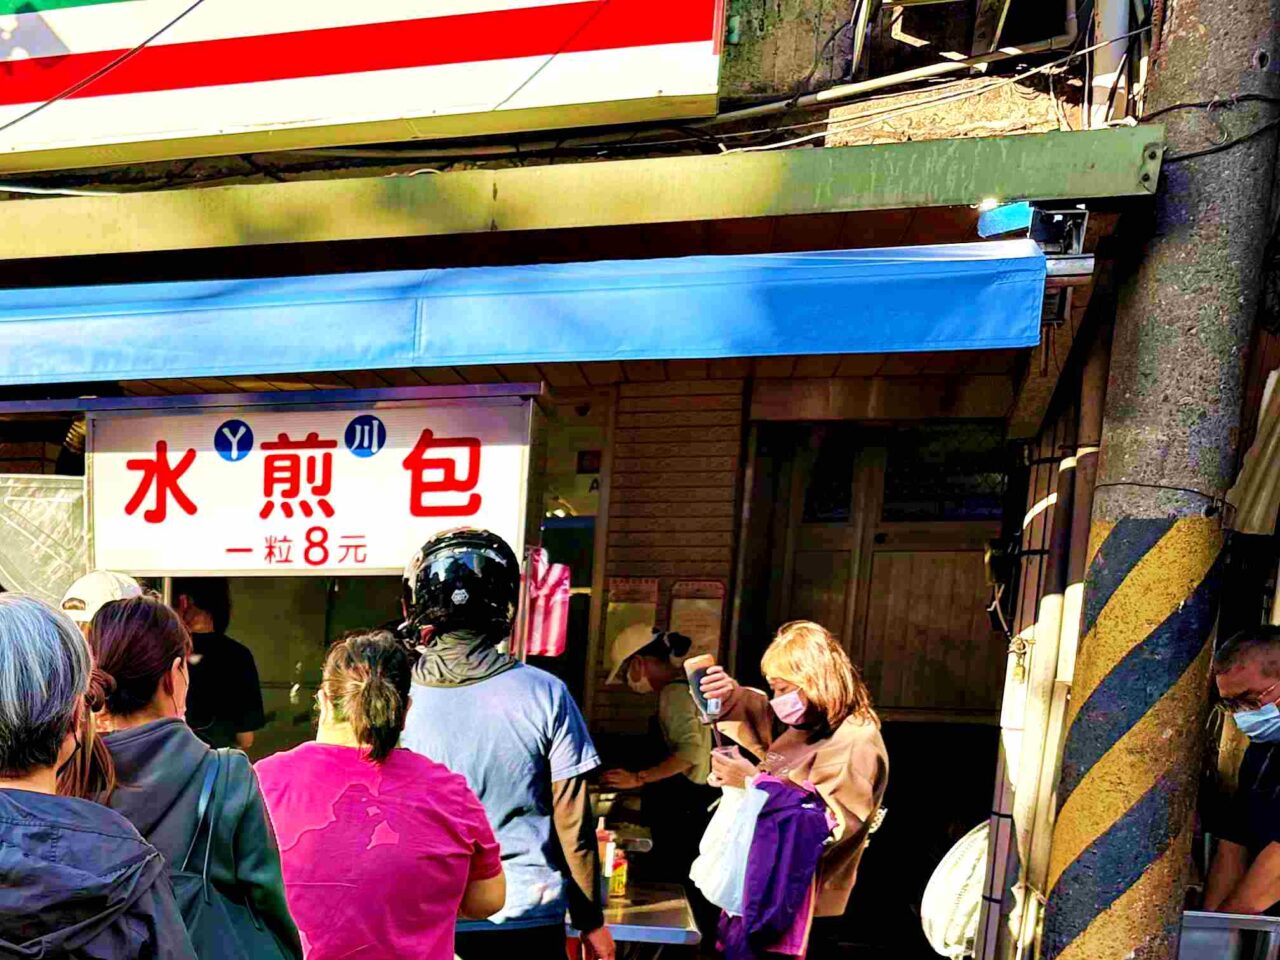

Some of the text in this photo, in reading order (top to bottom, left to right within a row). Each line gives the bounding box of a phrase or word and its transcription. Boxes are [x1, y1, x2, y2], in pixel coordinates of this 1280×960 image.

[124, 428, 483, 524] 水煎包
[226, 525, 368, 566] 一粒8元
